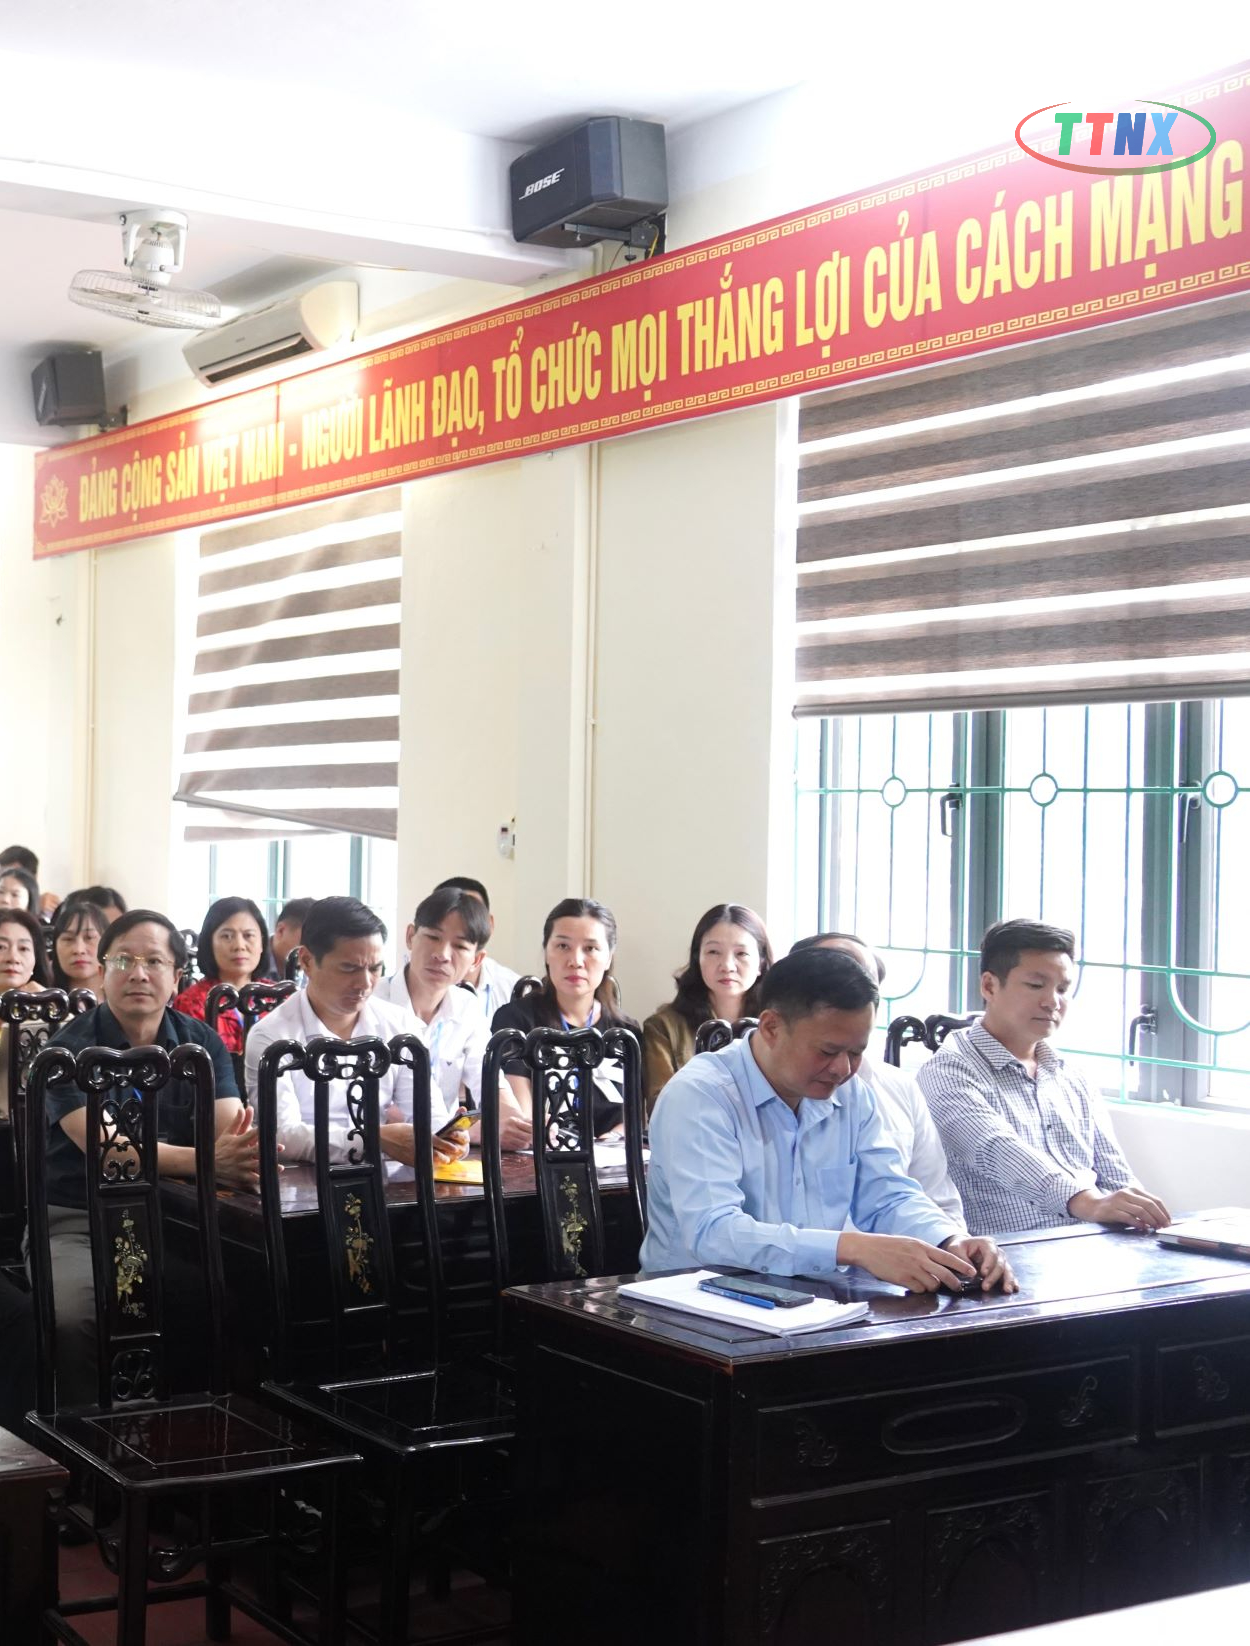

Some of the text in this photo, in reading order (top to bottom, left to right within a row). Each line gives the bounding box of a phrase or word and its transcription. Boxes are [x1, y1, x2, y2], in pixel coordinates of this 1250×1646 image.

[521, 169, 564, 199] BOSE
[79, 457, 118, 523] ĐẢNG
[121, 444, 162, 522] CỘNG
[166, 431, 199, 502] SẢN
[202, 434, 238, 502] VIỆT
[241, 422, 286, 486] NAM
[302, 393, 364, 470] NGƯỜI
[368, 378, 425, 453] LÃNH
[432, 365, 485, 447] ĐẠO,
[492, 326, 525, 423] TỔ
[531, 321, 602, 413] CHỨC
[611, 310, 667, 402] MỌI
[677, 262, 784, 376] THẮNG
[796, 250, 850, 358] LỢI
[863, 210, 942, 328] CỦA
[955, 190, 1074, 305] CÁCH
[1090, 139, 1243, 279] MẠNG
